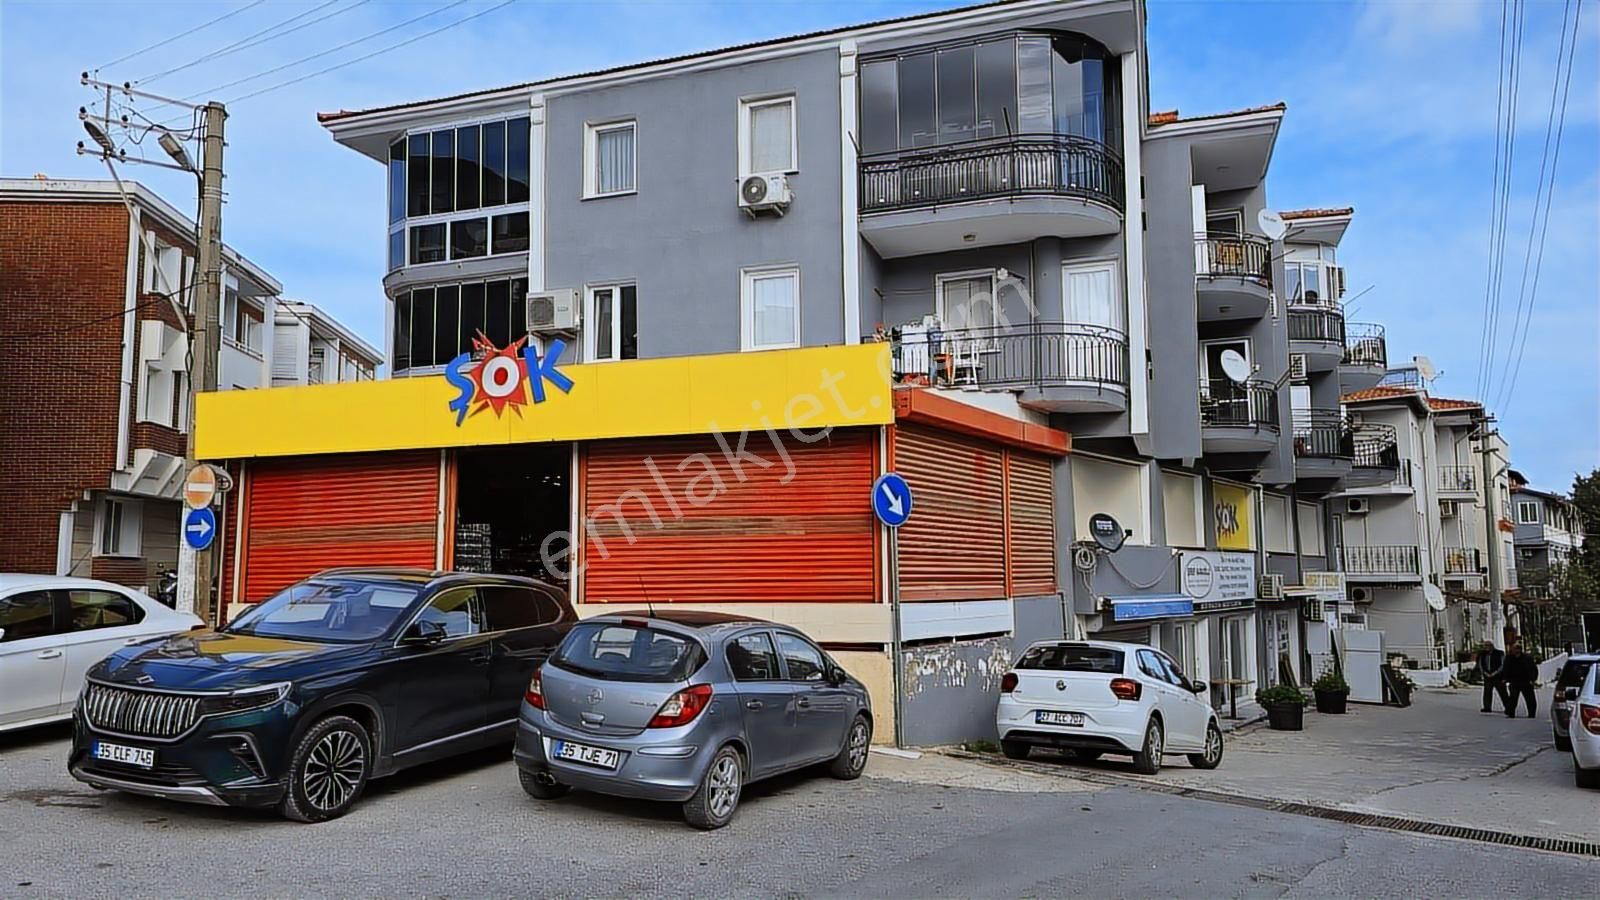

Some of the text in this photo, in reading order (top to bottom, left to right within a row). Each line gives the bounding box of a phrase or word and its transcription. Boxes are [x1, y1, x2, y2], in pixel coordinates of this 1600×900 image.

[445, 338, 575, 427] ŞOK
[1215, 503, 1240, 541] ŞOK
[99, 744, 111, 758] 35
[114, 746, 131, 761] CLF
[561, 743, 617, 766] 35 TJE 71
